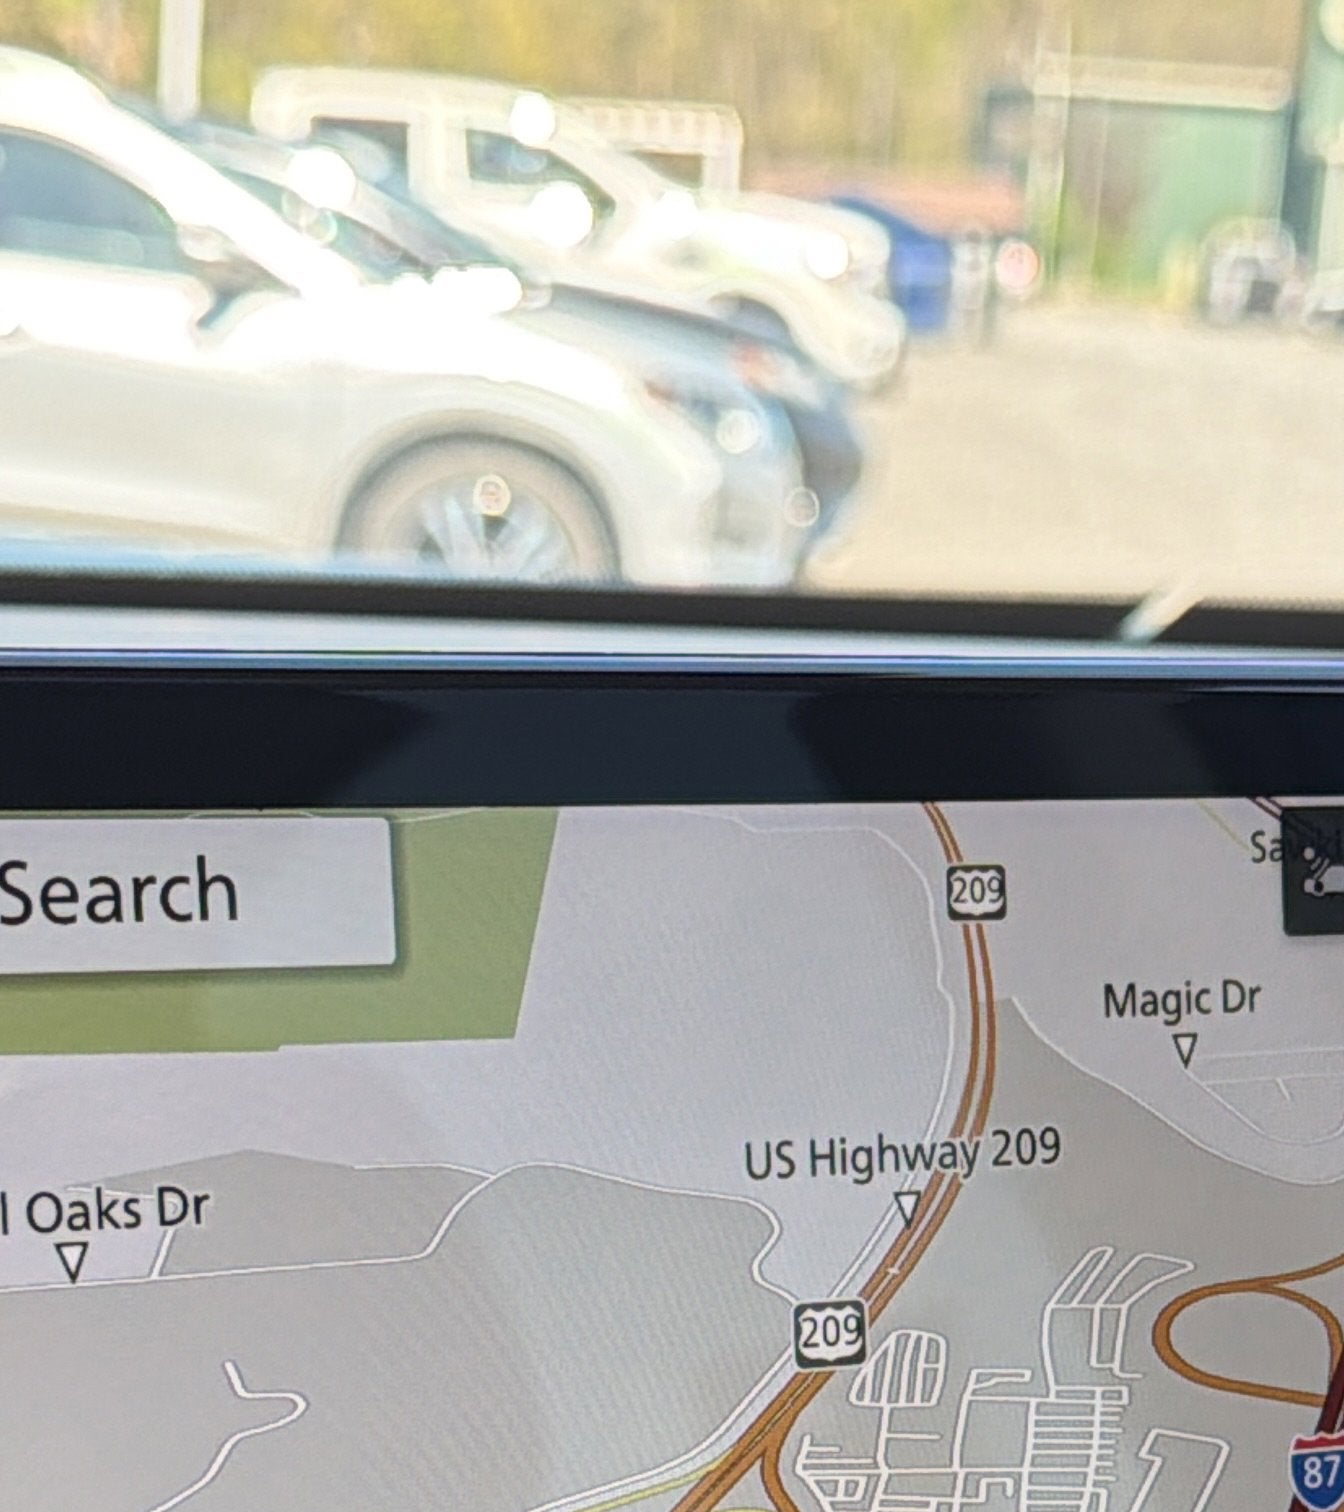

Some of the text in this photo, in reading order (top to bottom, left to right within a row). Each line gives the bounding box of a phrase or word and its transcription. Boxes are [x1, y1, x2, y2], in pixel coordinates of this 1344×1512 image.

[951, 875, 1005, 905] 209
[1102, 979, 1262, 1026] Magic Dr
[744, 1126, 1062, 1185] US Highway 209
[27, 1187, 142, 1235] Oaks
[158, 1185, 210, 1227] Dr
[801, 1316, 862, 1350] 209
[1302, 1455, 1341, 1489] 87
